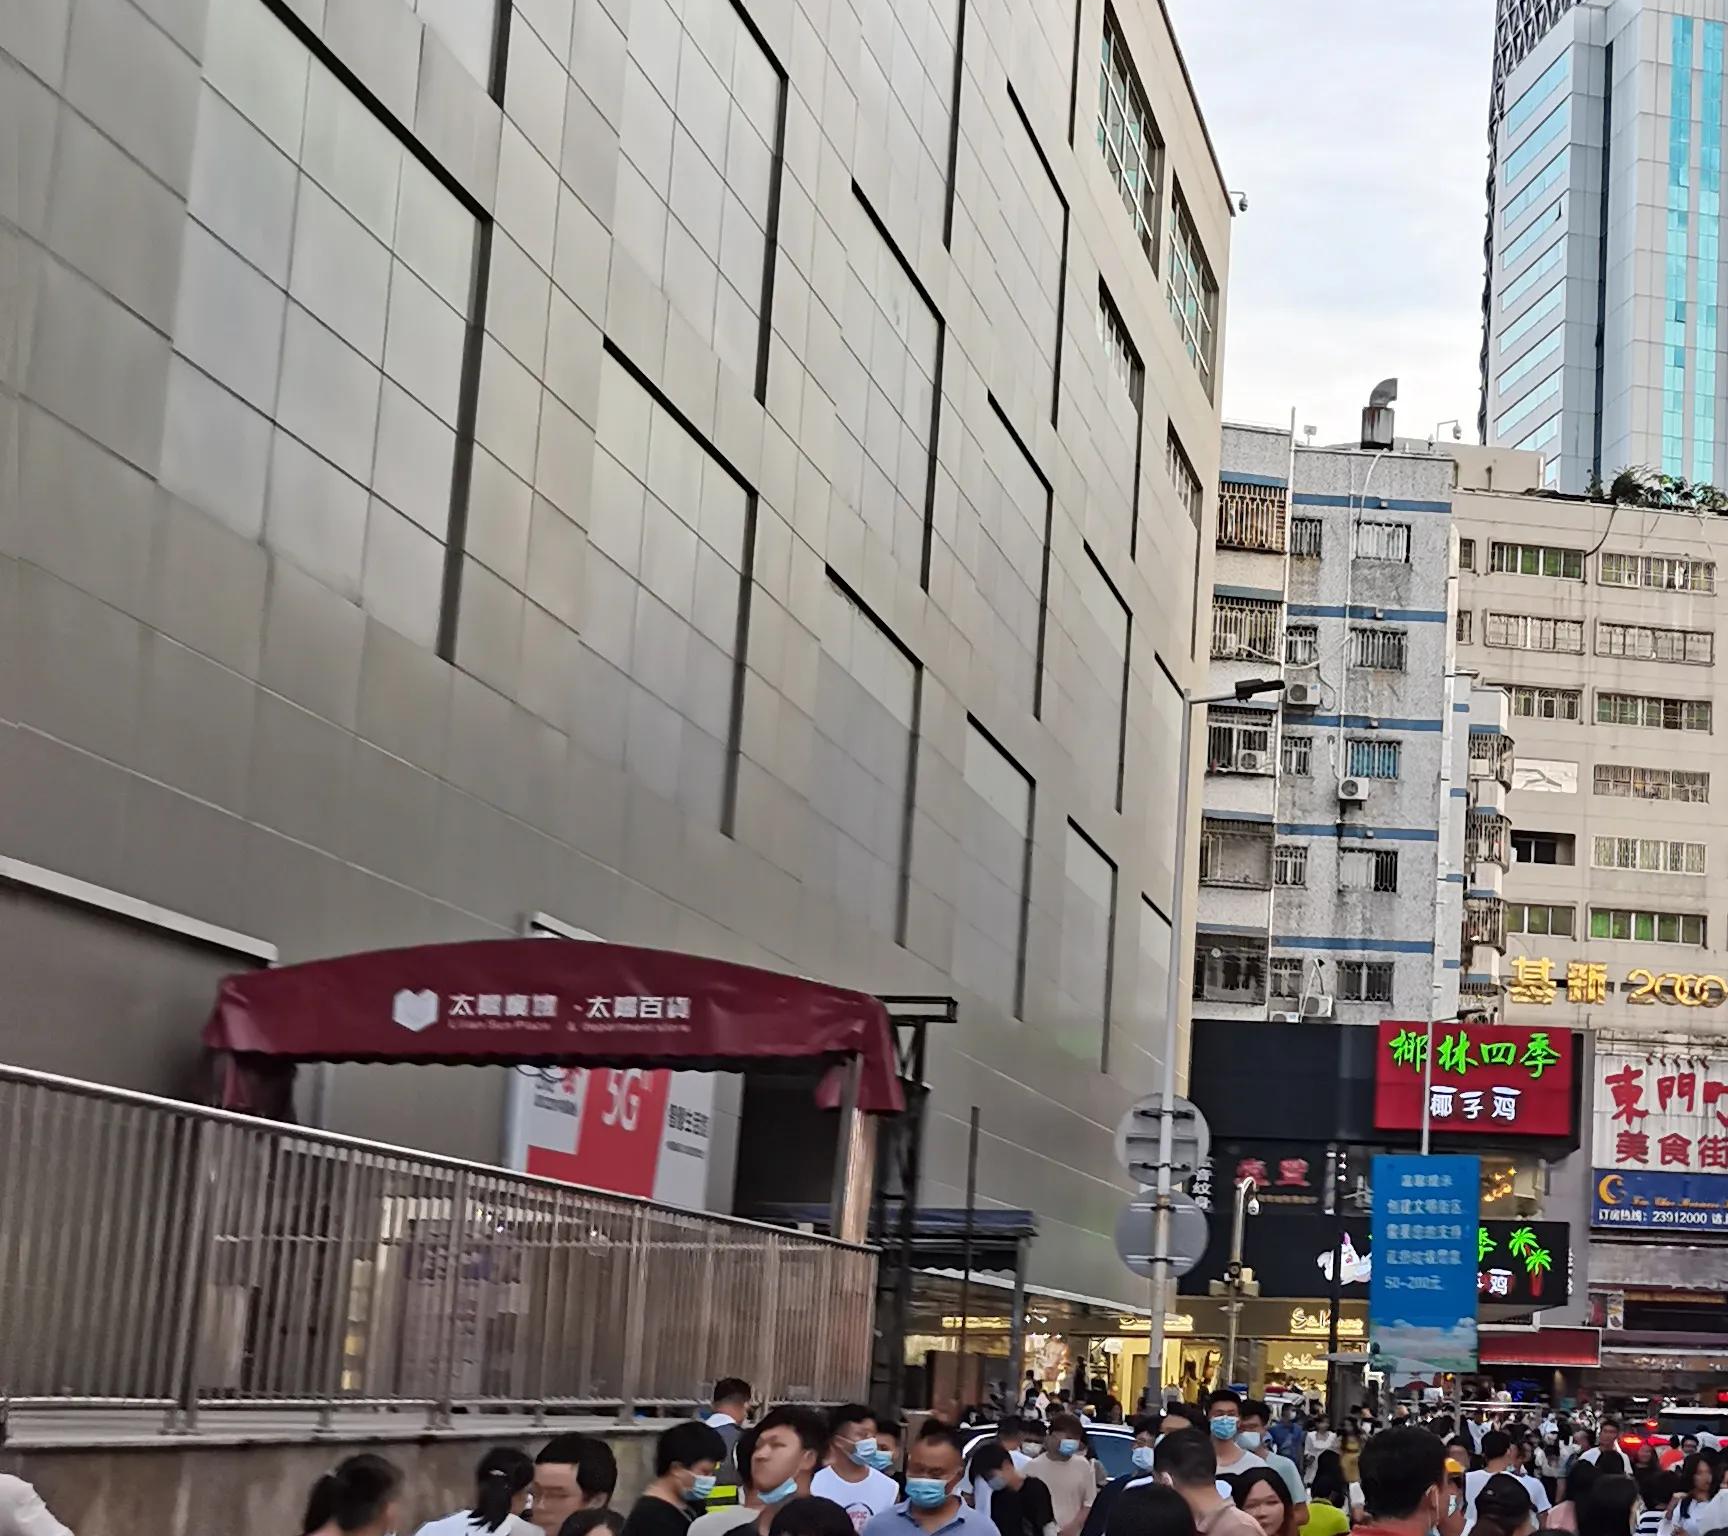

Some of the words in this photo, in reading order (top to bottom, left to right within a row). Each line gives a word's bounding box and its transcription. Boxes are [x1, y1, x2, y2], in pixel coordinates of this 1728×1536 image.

[1389, 1028, 1560, 1080] 椰林四季
[1430, 1086, 1521, 1121] 椰子鸡
[1652, 1211, 1707, 1224] 23912000
